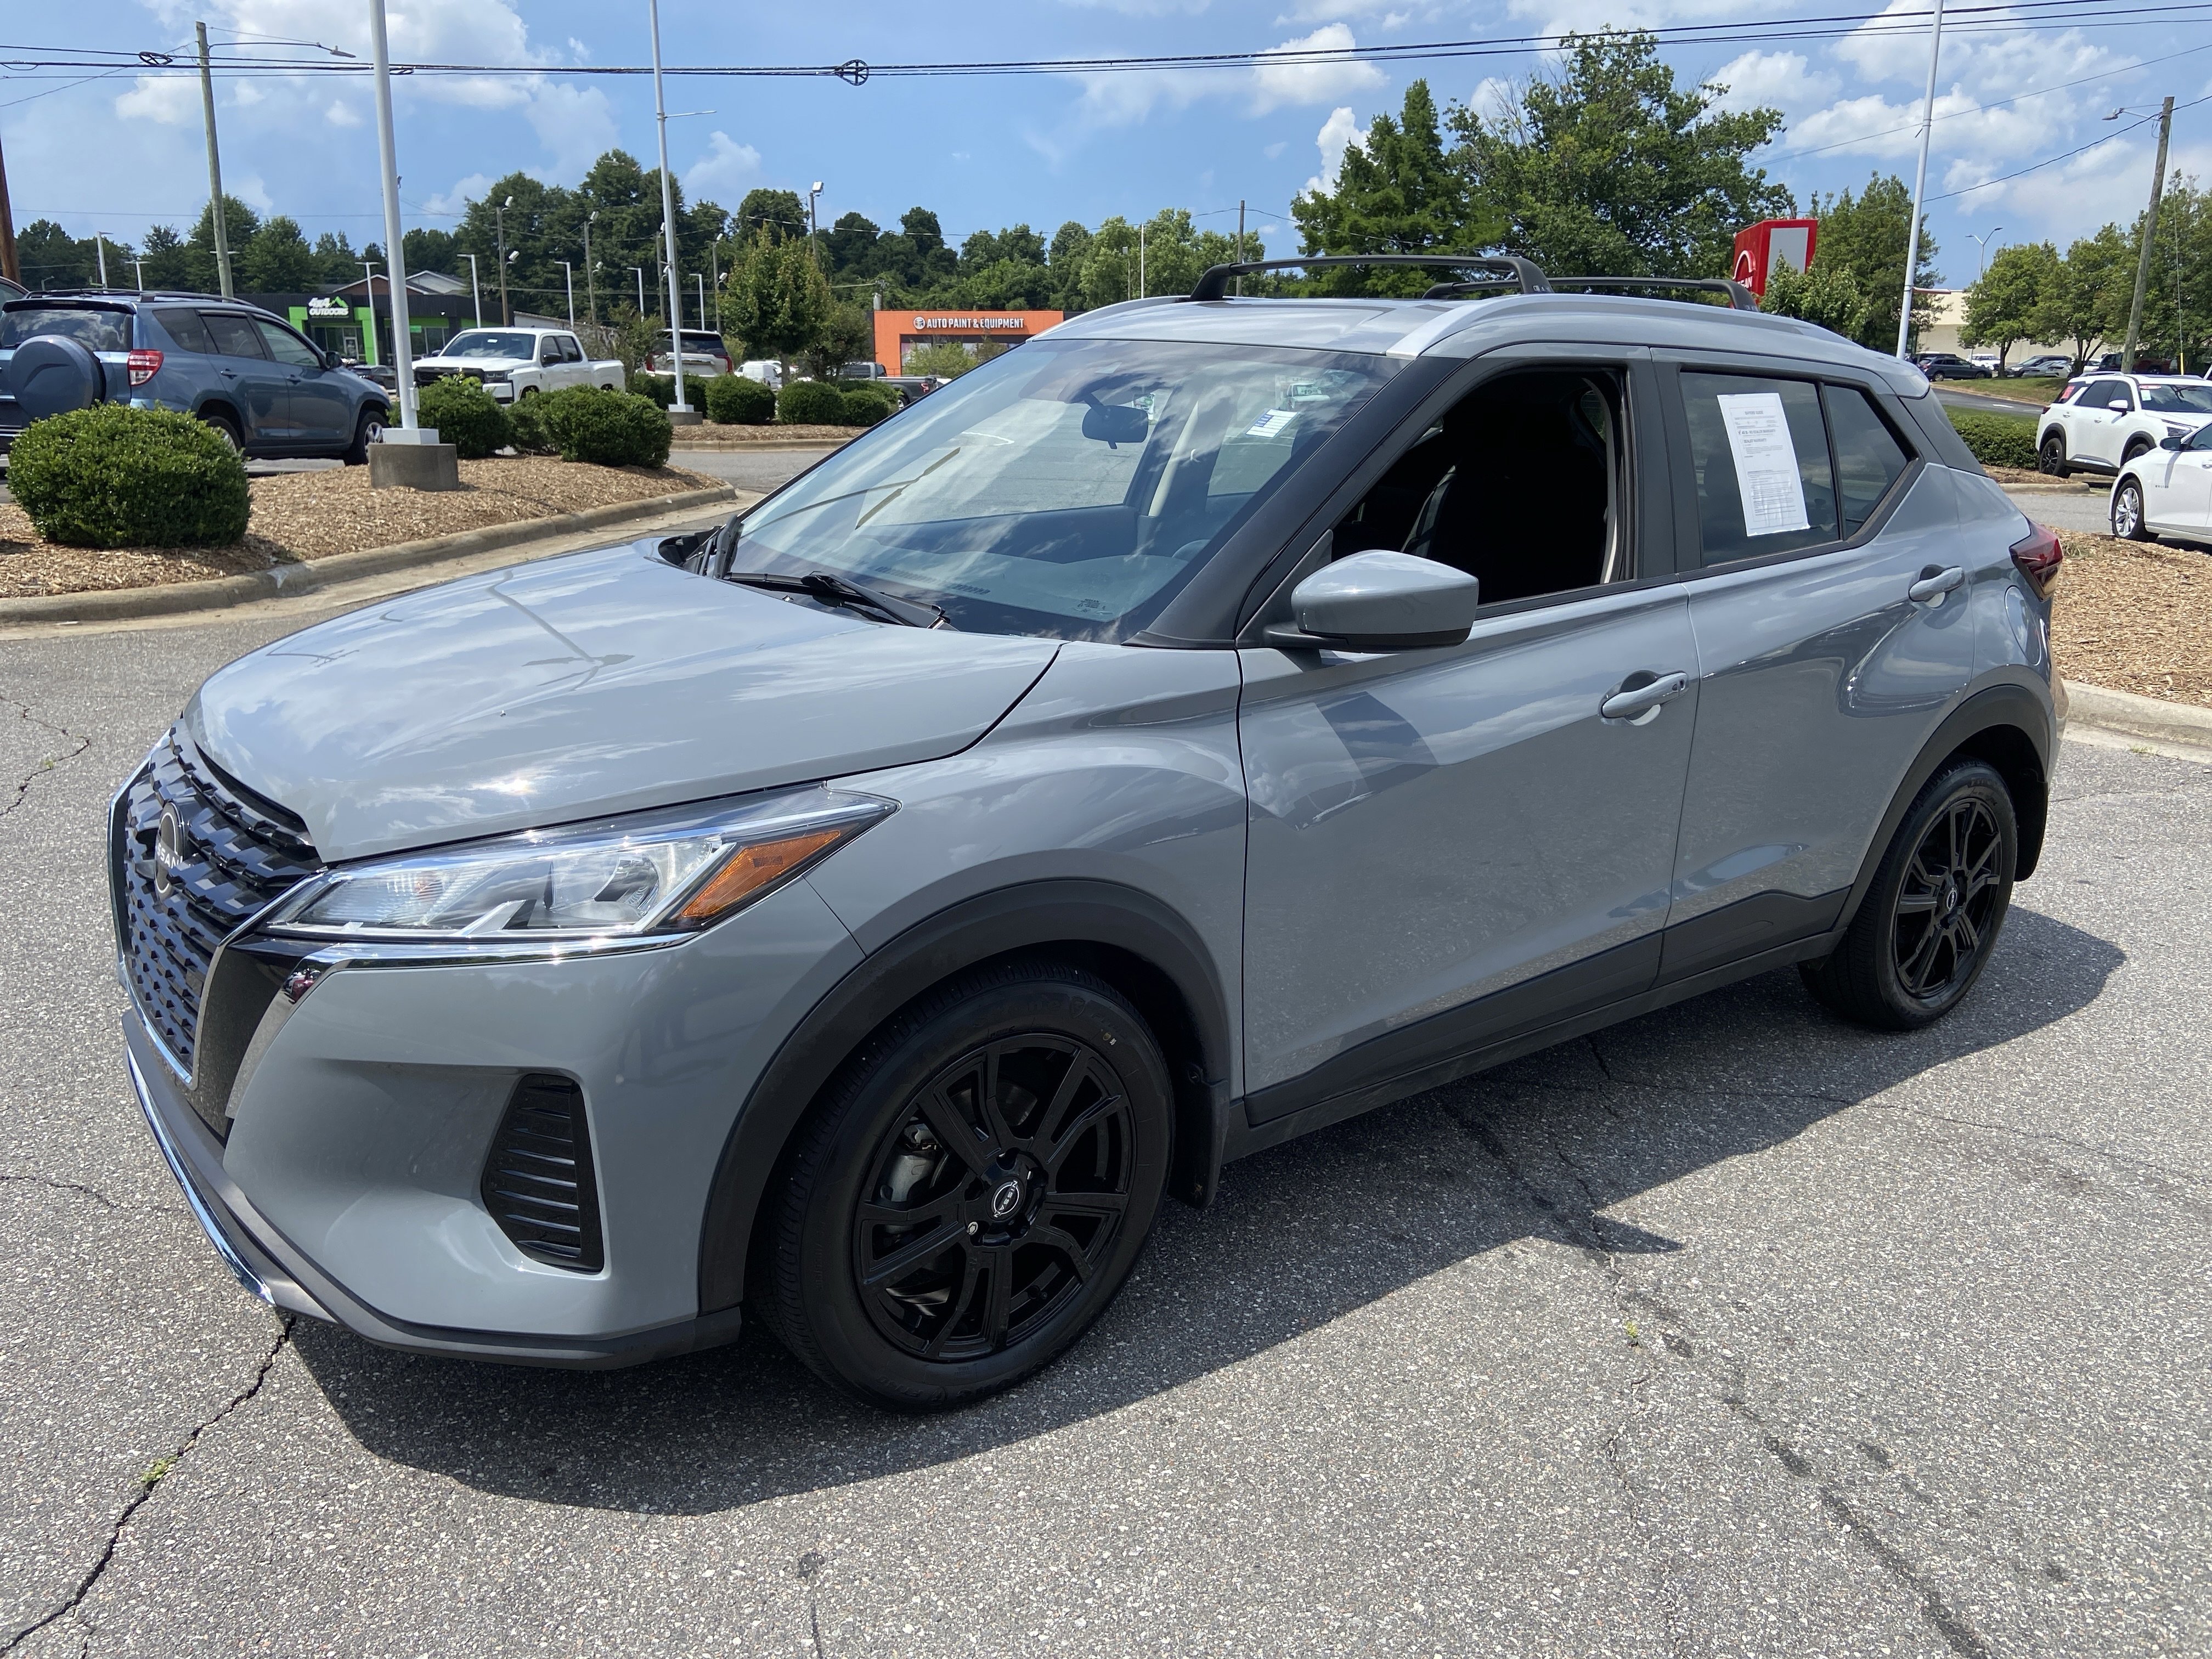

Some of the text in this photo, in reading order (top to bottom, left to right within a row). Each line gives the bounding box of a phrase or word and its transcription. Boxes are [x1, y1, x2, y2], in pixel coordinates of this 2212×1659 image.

[1737, 276, 1753, 289] SAN
[309, 308, 349, 316] OUTDOORS
[927, 318, 947, 328] AUTO
[949, 318, 971, 328] PAINT
[973, 318, 979, 329] &
[980, 318, 1024, 329] EQUIPMENT
[157, 843, 183, 869] SSAN
[994, 1180, 1018, 1218] NISSAN
